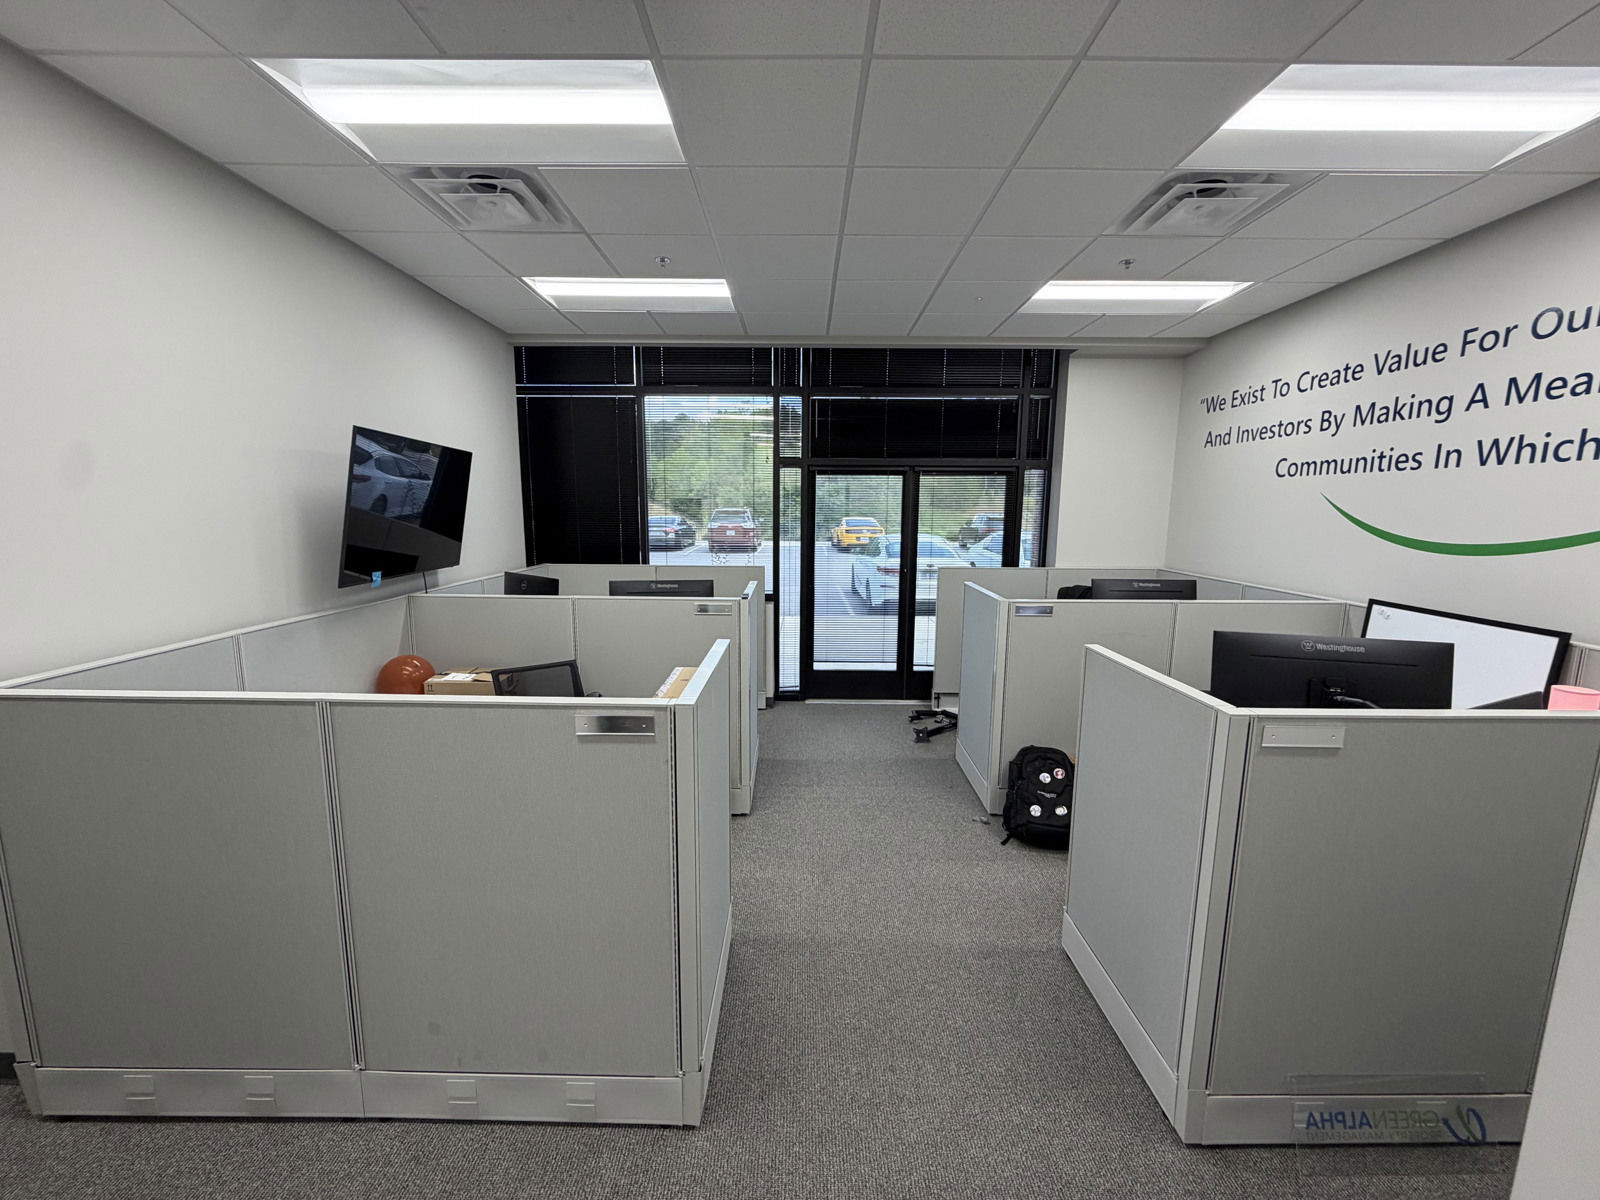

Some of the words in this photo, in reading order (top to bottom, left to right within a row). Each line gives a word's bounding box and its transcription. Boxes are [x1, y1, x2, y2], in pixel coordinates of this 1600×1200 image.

[1230, 384, 1267, 409] Exist
[1271, 378, 1291, 400] To
[1296, 363, 1365, 394] Create
[1373, 343, 1449, 376] Value
[1459, 327, 1519, 358] For
[1530, 305, 1600, 340] Ou
[1203, 427, 1233, 449] And
[1235, 416, 1313, 444] Investors
[1319, 409, 1346, 438] By
[1352, 393, 1455, 428] Making
[1463, 382, 1490, 413] A
[1504, 371, 1600, 407] Mea
[1275, 447, 1424, 479] Communities
[1433, 443, 1463, 470] In
[1476, 427, 1600, 467] Which
[1315, 642, 1366, 653] Westinghouse
